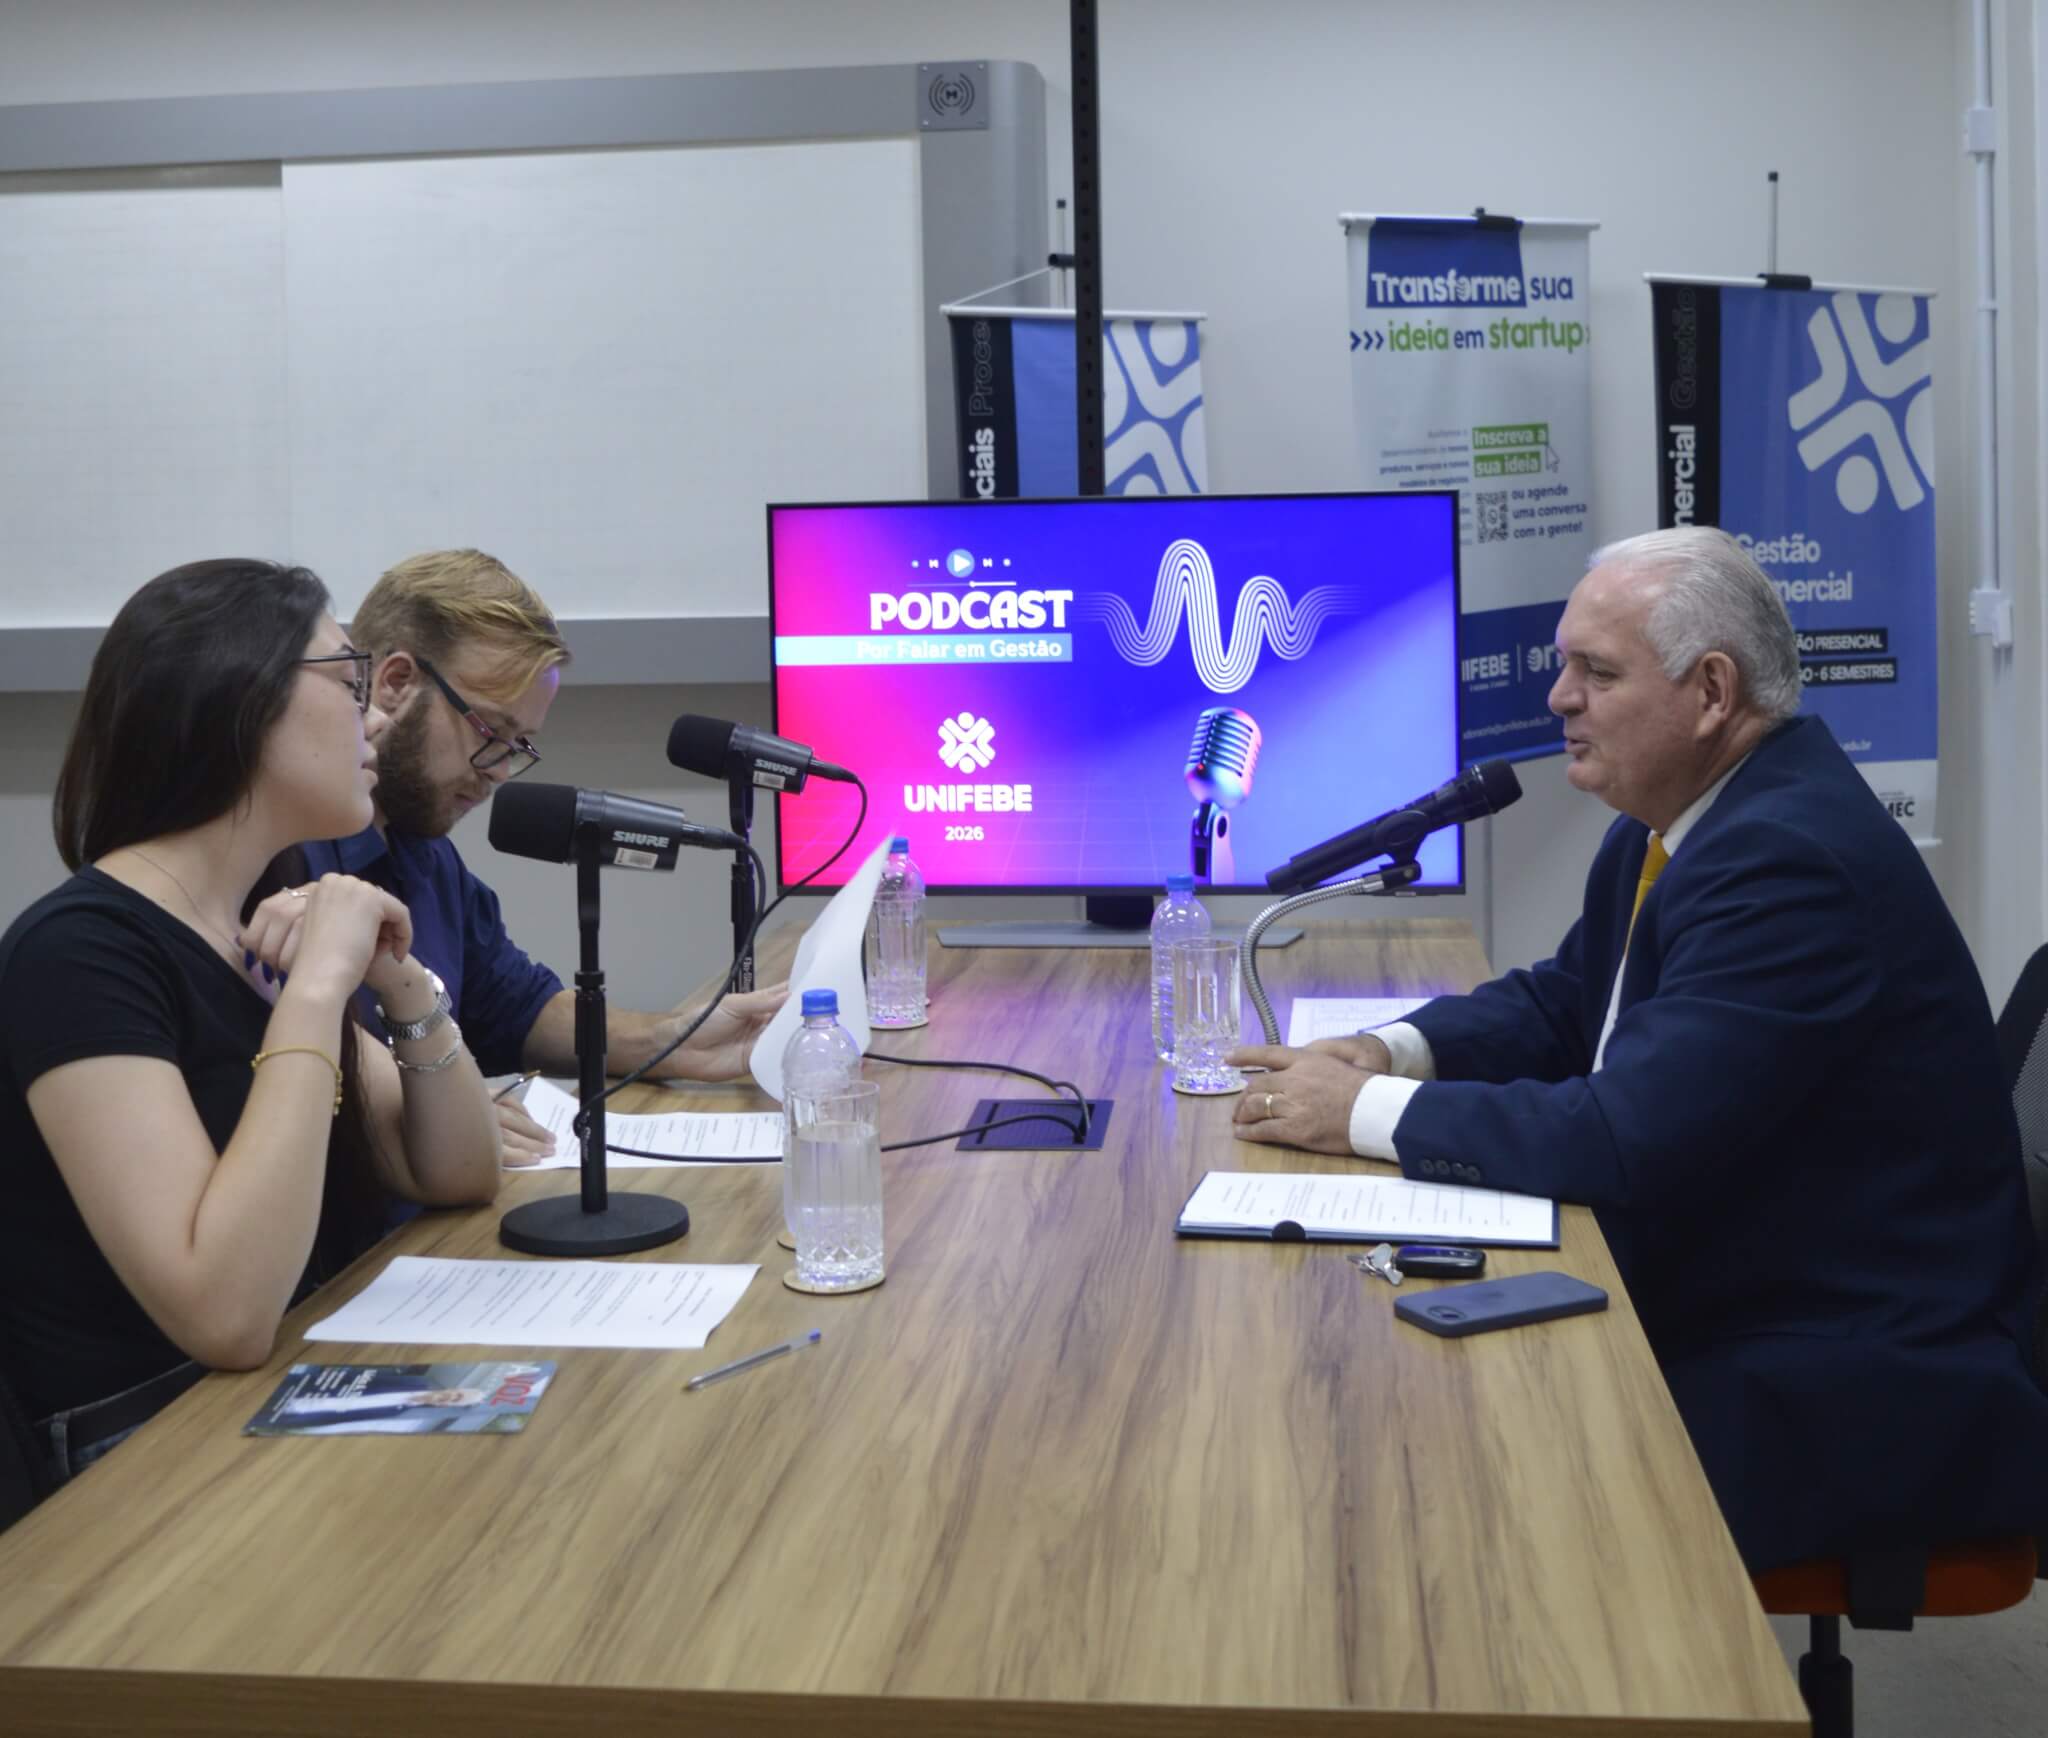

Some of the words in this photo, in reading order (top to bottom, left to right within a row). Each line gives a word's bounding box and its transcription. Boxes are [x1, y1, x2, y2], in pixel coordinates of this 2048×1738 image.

[1370, 269, 1521, 303] Transforme
[1530, 276, 1574, 300] sua
[1388, 320, 1449, 351] ideia
[1453, 330, 1484, 349] em
[1489, 317, 1583, 353] startup
[1474, 430, 1534, 447] Inscreva
[1537, 429, 1547, 441] a
[968, 427, 996, 499] ciais
[1476, 460, 1501, 474] sua
[1504, 454, 1539, 472] ideia
[1512, 489, 1525, 500] ou
[1527, 484, 1568, 502] agende
[1512, 508, 1535, 519] uma
[1538, 503, 1587, 517] conversa
[1513, 528, 1536, 538] com
[1538, 526, 1544, 536] a
[869, 589, 1073, 631] PODCAST
[954, 644, 985, 658] em
[989, 639, 1063, 658] Gestão
[1816, 634, 1882, 650] PRESENCIAL
[1461, 653, 1510, 682] IFEBE
[1820, 666, 1828, 681] 6
[1830, 664, 1894, 681] SEMESTRES
[754, 758, 798, 777] SHURE
[904, 784, 1033, 812] UNIFEBE
[612, 830, 670, 848] SHURE
[945, 826, 984, 841] 2026
